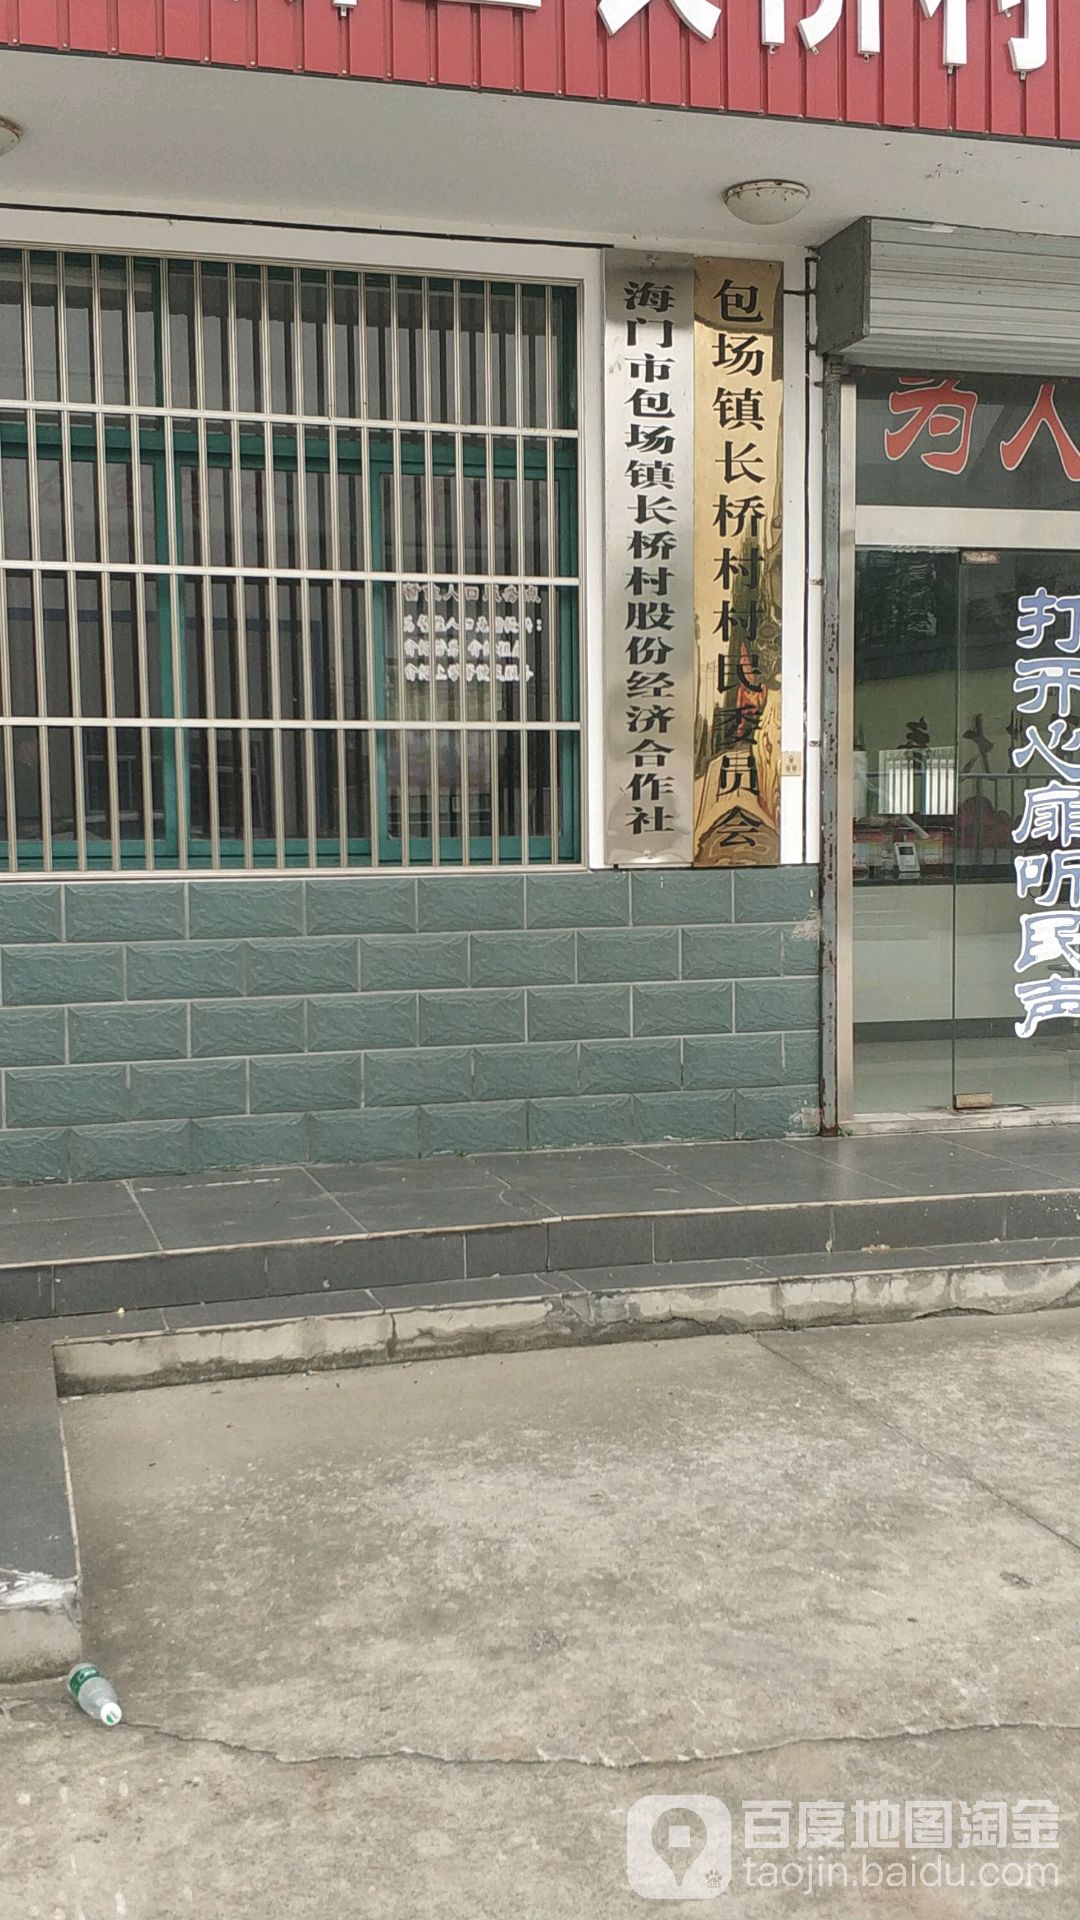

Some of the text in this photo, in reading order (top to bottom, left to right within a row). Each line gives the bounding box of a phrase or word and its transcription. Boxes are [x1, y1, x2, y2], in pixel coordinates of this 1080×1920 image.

[624, 280, 677, 835] 海门市包场镇长桥村股份经济合作社
[711, 278, 767, 848] 包场镇长桥村村民委员会
